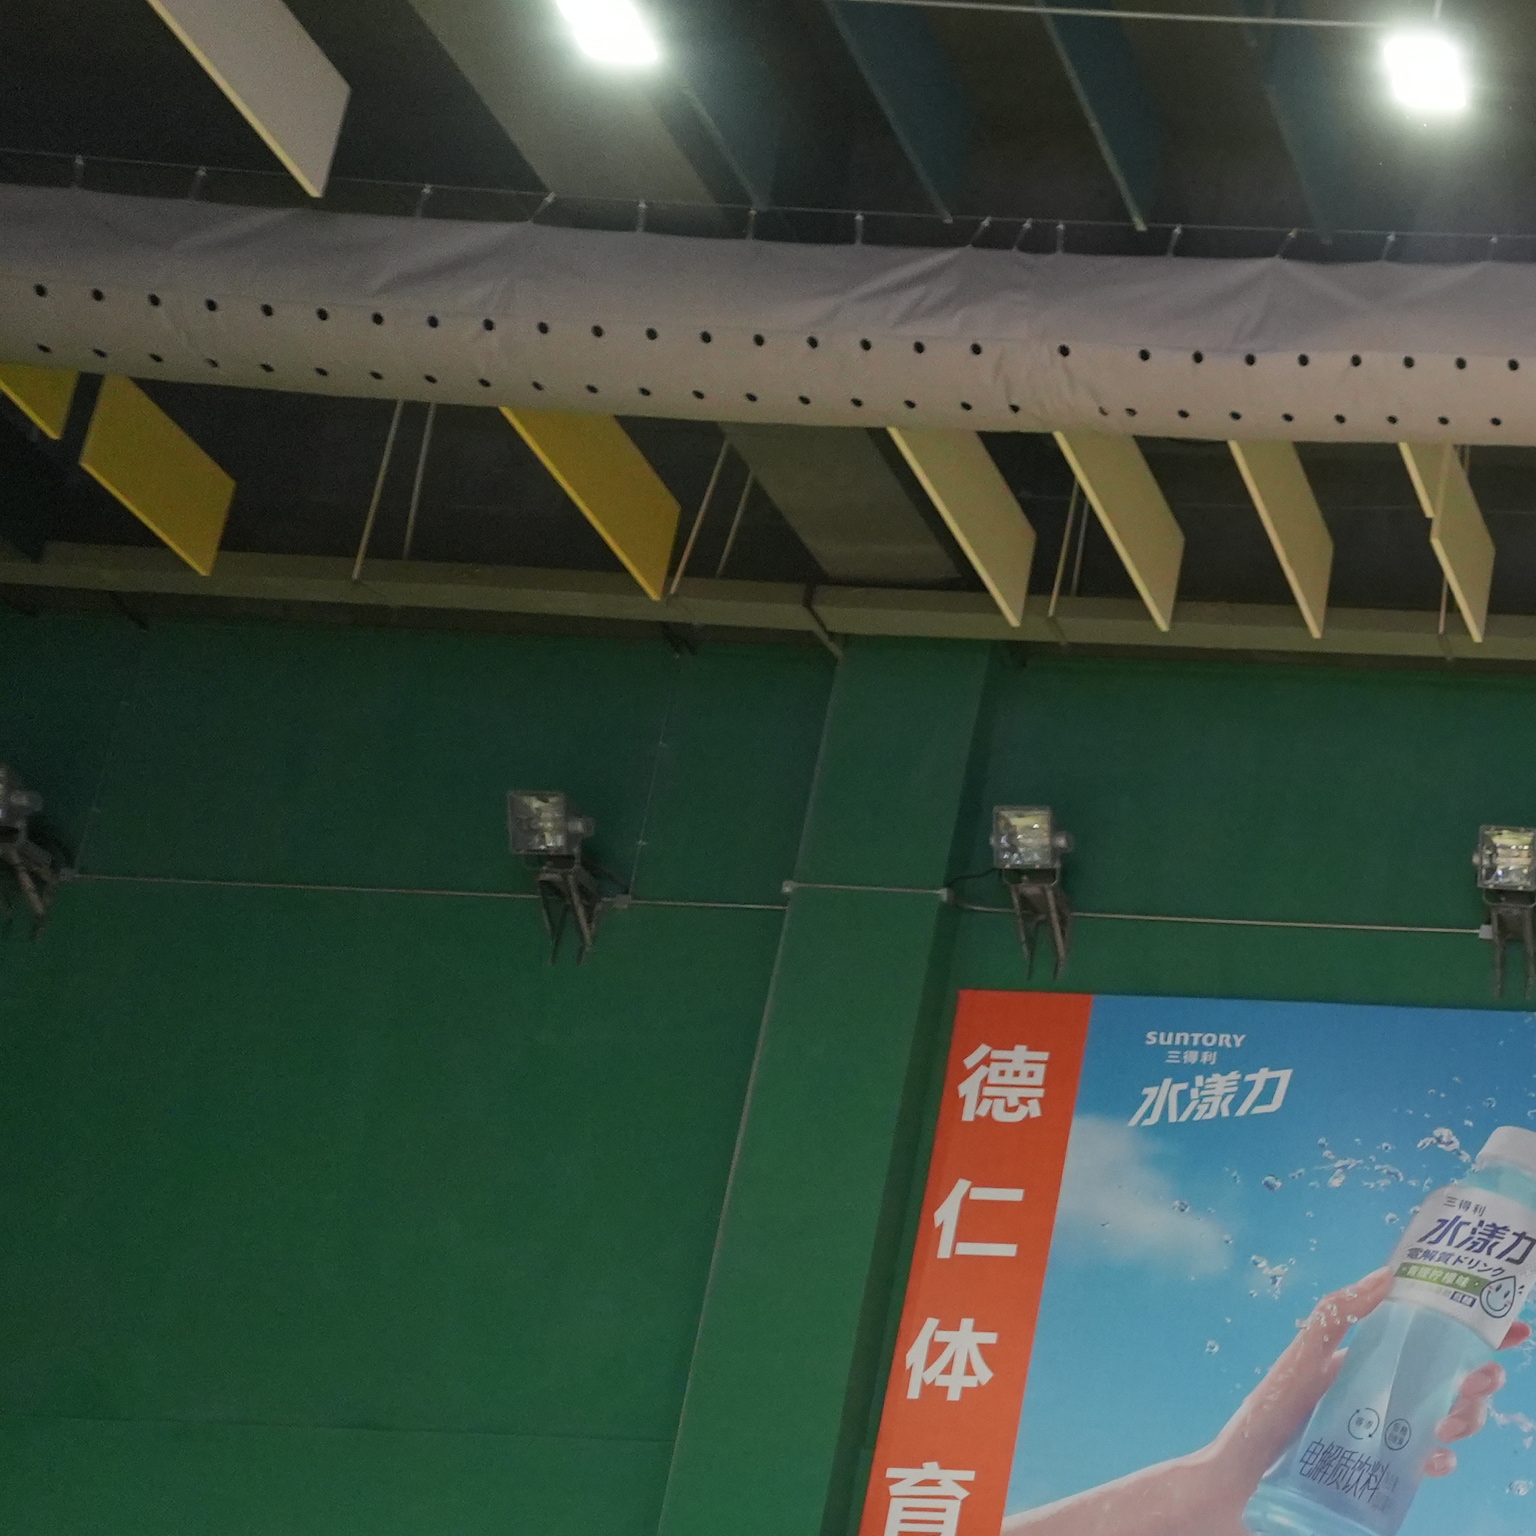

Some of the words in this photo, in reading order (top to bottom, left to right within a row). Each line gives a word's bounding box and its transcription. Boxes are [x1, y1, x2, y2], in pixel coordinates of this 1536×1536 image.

[1164, 1050, 1217, 1065] 三得利
[1127, 1067, 1293, 1127] 水漾力
[1444, 1195, 1487, 1217] 三得利
[1300, 1437, 1391, 1503] 电解质饮料
